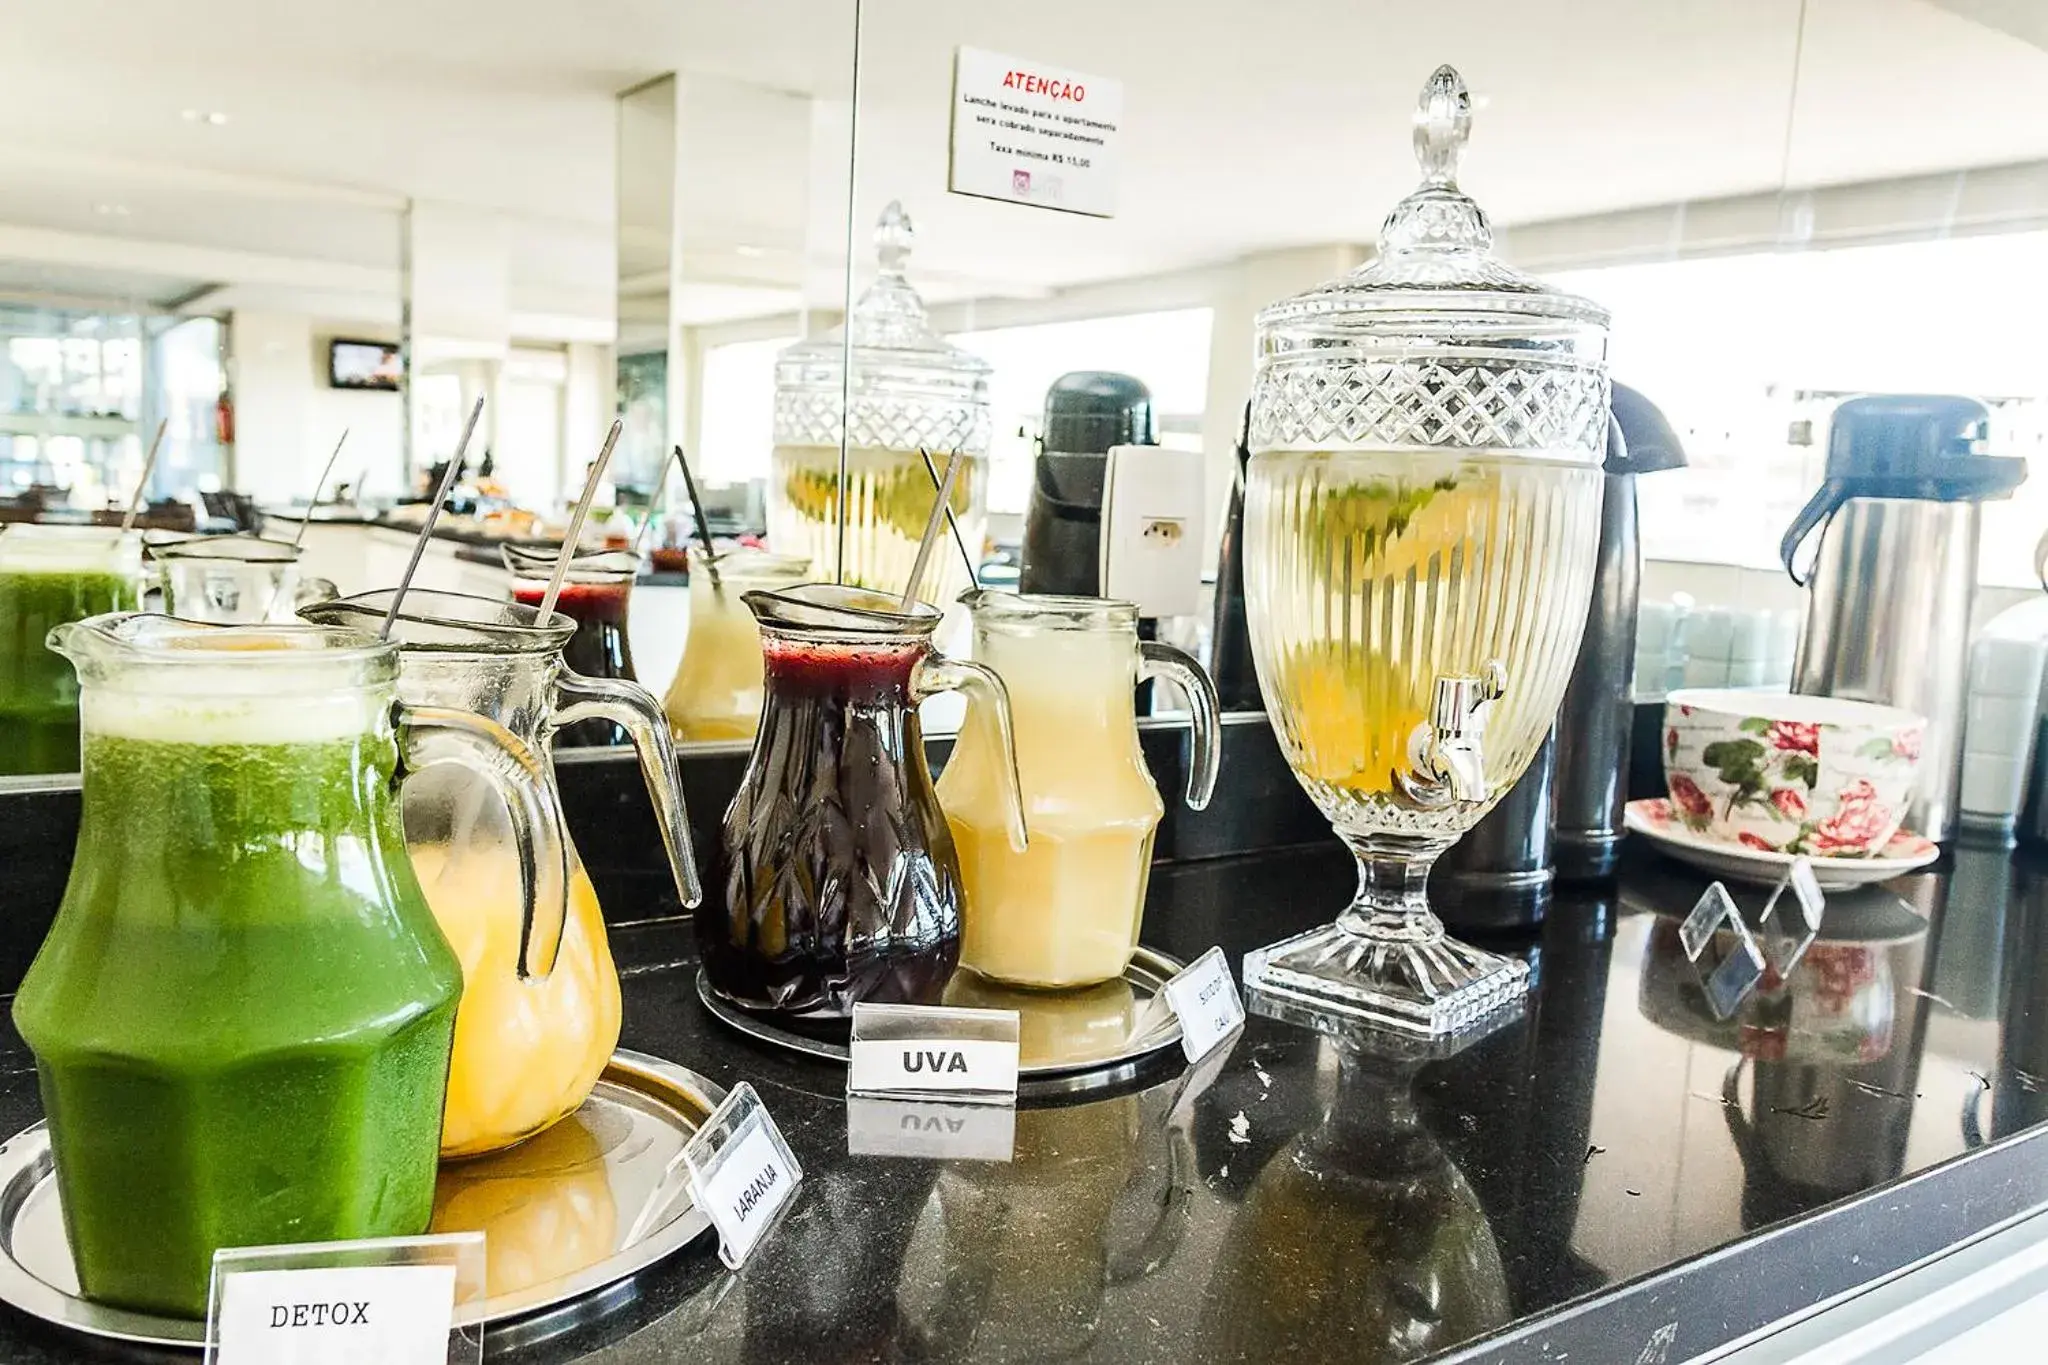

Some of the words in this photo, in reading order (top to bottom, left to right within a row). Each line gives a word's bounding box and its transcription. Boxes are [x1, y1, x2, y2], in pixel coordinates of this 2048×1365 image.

[1003, 71, 1085, 101] ATENÇÃO
[963, 93, 997, 107] Lanche
[1001, 101, 1029, 114] levado
[1032, 108, 1052, 120] para
[1063, 115, 1117, 132] apartamento
[999, 119, 1035, 134] cobrado
[1038, 127, 1104, 146] separadamente
[989, 141, 1013, 154] Taxa
[1052, 154, 1064, 164] R$
[903, 1051, 968, 1073] UVA
[733, 1163, 779, 1223] LARANJA
[270, 1302, 370, 1328] DETOX
